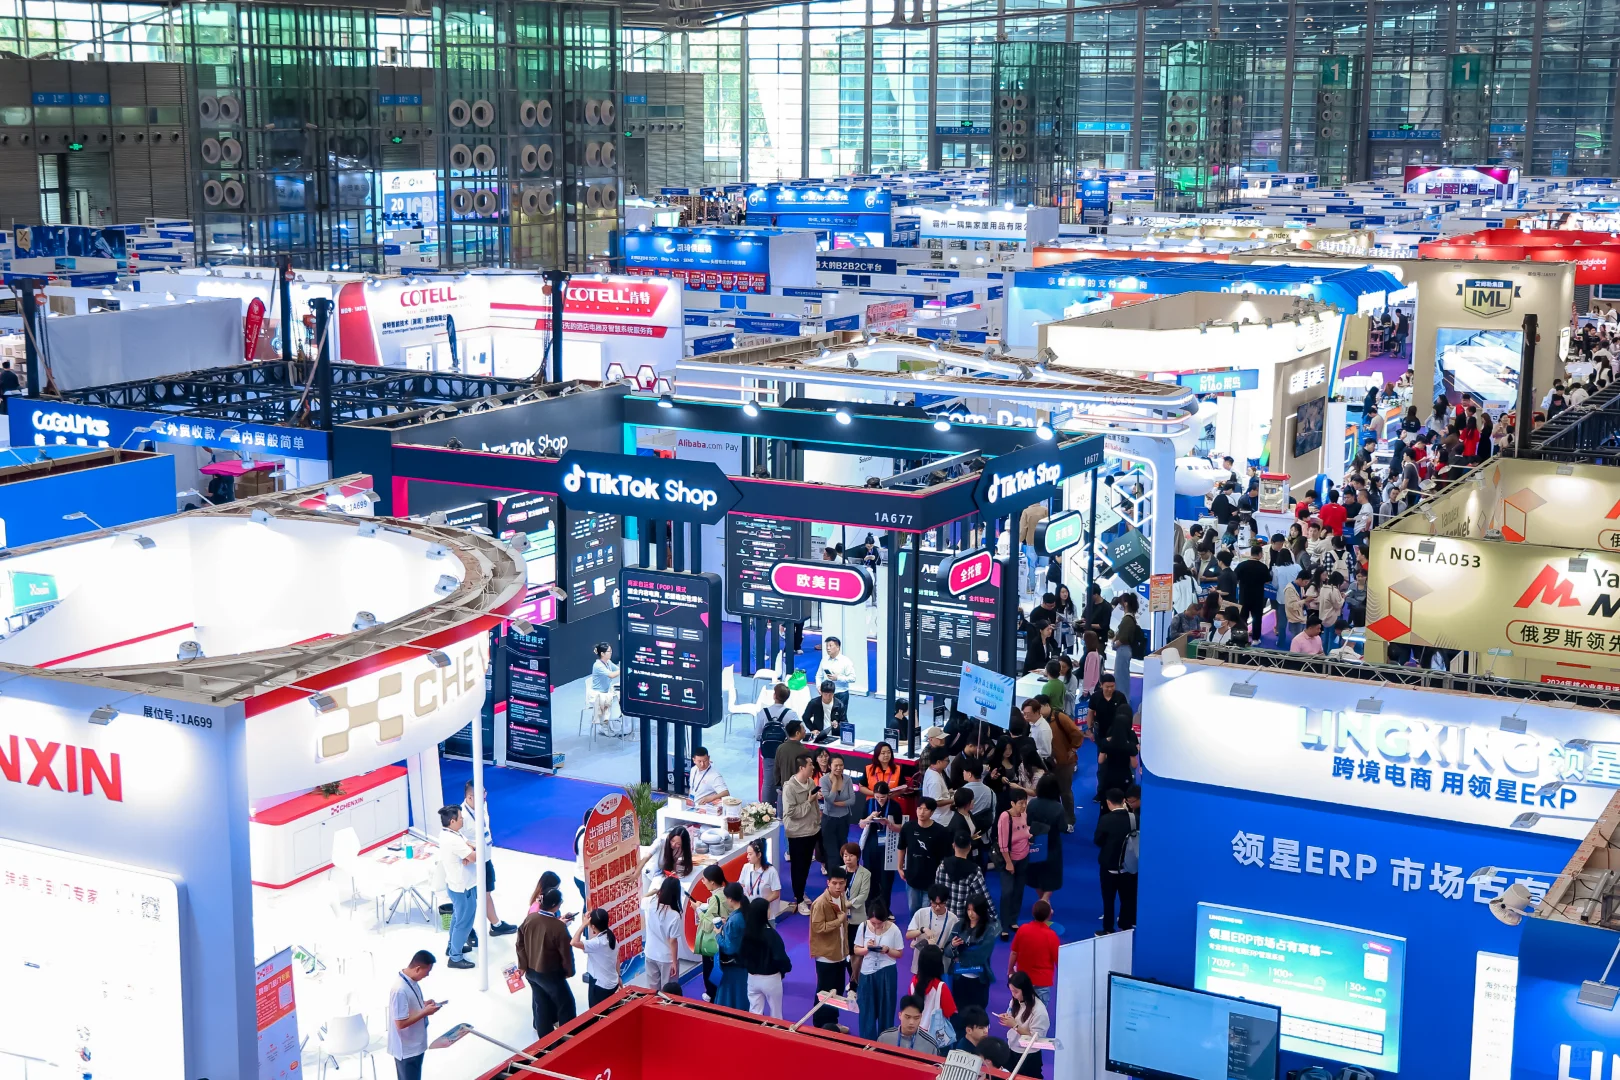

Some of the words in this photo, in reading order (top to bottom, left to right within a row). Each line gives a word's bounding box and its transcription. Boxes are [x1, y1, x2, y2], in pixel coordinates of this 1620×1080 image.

[1330, 63, 1339, 81] 1
[1461, 61, 1471, 81] 1
[400, 286, 457, 308] COTELL
[565, 287, 630, 304] COTELL
[1472, 290, 1507, 308] IML
[678, 438, 723, 451] Alibaba.com
[725, 443, 739, 452] Pay
[1001, 470, 1036, 499] TikTok
[1036, 461, 1061, 486] Shop
[586, 472, 660, 501] TikTok
[664, 479, 718, 511] Shop
[874, 511, 913, 525] 1A677
[796, 573, 841, 592] 欧美日
[142, 705, 213, 729] 展位号:1A699
[1331, 756, 1433, 791] 跨境电商
[1230, 829, 1378, 882] 领星ERP
